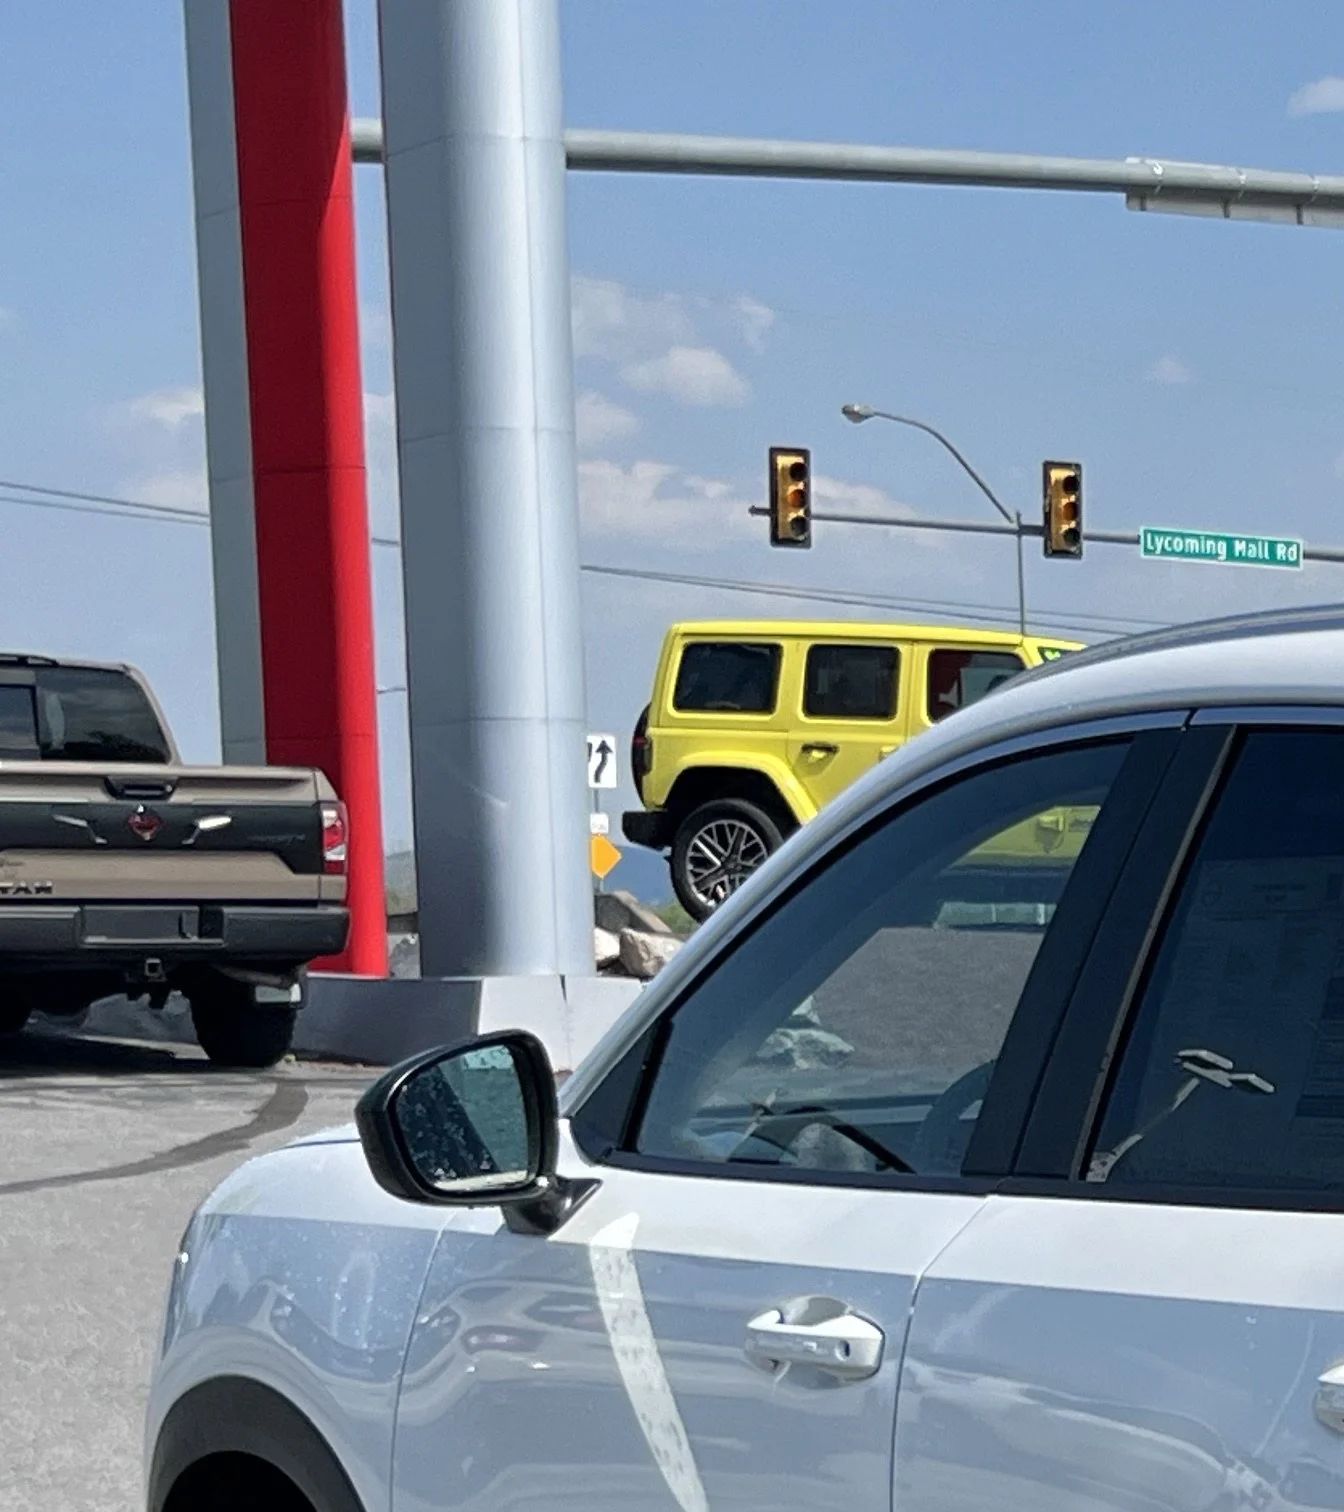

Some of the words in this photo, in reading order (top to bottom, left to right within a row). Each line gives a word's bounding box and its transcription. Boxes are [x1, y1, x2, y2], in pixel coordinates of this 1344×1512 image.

[1147, 532, 1227, 561] Lycoming
[1234, 539, 1269, 560] Mall
[1276, 543, 1298, 562] Rd
